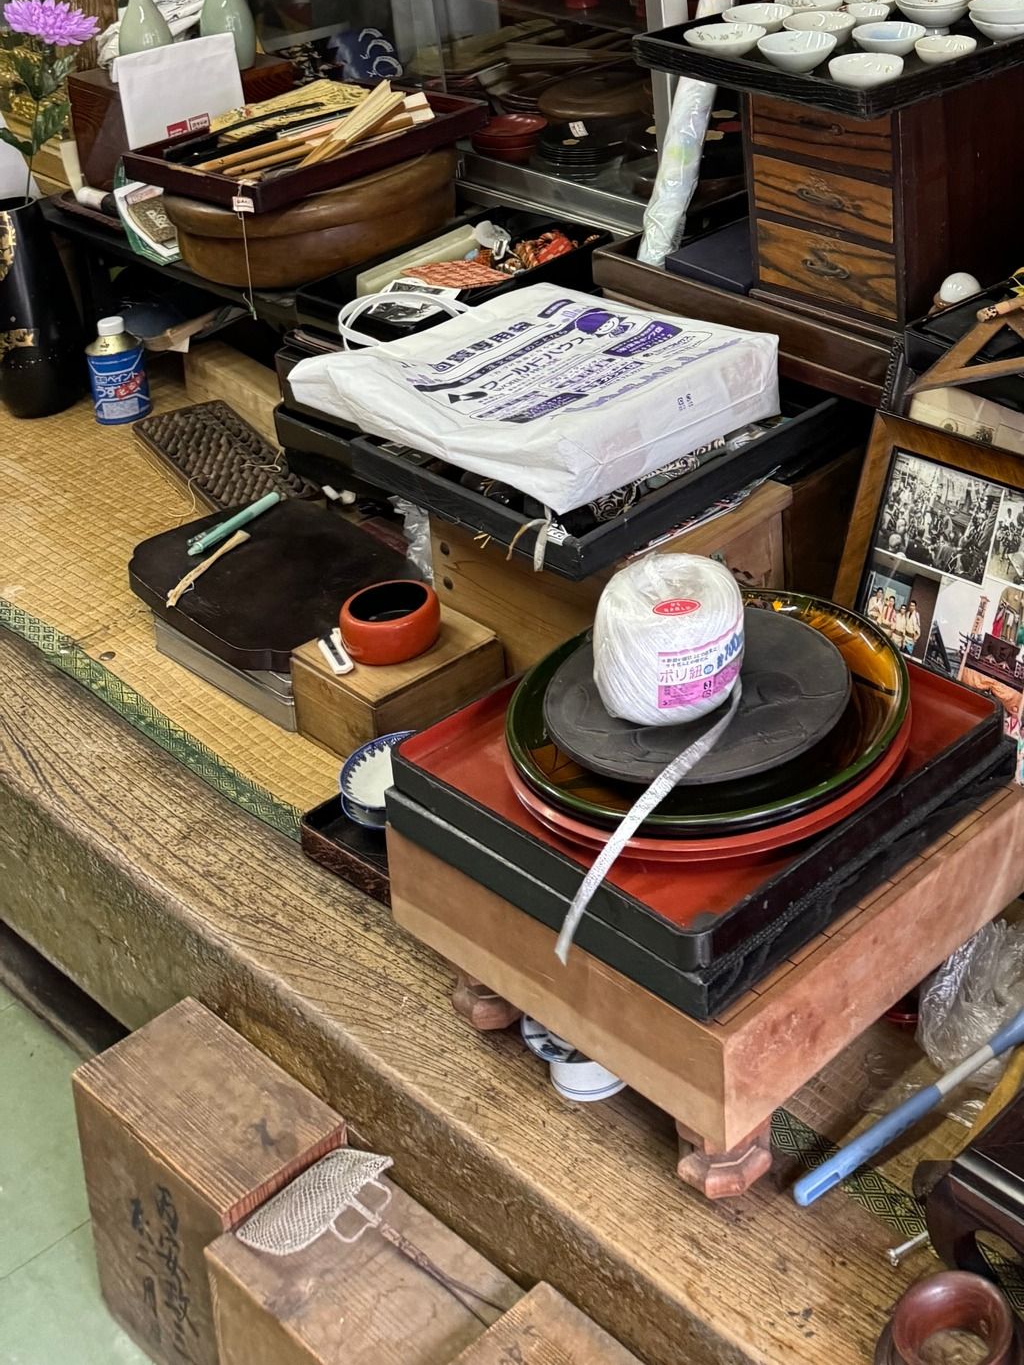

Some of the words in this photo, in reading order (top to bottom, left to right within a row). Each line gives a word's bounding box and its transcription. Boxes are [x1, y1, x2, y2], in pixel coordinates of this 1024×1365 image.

[432, 321, 536, 373] 回覧専用袋
[479, 336, 593, 391] ワールドハウス
[659, 664, 703, 683] ポリ紐
